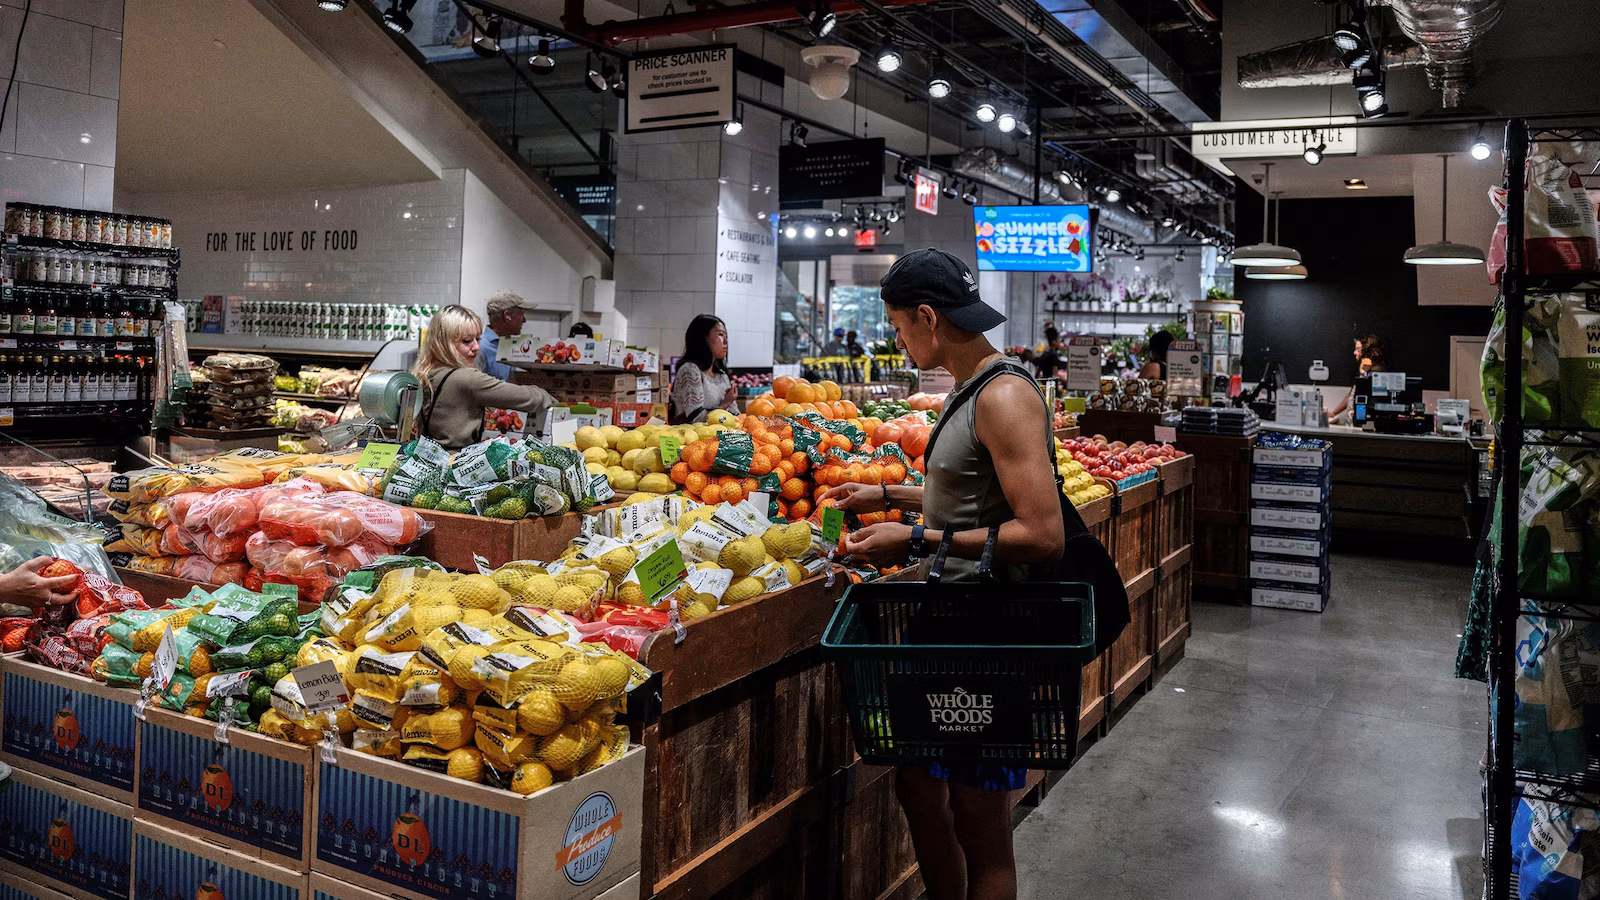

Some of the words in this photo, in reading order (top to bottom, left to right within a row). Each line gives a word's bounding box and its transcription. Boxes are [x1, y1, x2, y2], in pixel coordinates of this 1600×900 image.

[635, 56, 668, 71] PRICE
[671, 50, 726, 66] SCANNER
[665, 80, 682, 88] prices
[684, 77, 704, 85] located
[994, 221, 1068, 237] SUMMER
[207, 232, 228, 252] FOR
[236, 232, 256, 251] THE
[264, 232, 294, 250] LOVE
[302, 231, 316, 250] OF
[324, 230, 358, 250] FOOD
[995, 236, 1071, 256] SIZZLE
[458, 460, 485, 478] limes
[692, 526, 724, 544] lemons
[298, 678, 322, 690] Lemon
[322, 674, 340, 684] Bag
[926, 691, 994, 708] WHOLE
[930, 709, 993, 724] FOODS
[404, 728, 432, 738] lemons
[206, 783, 228, 800] DL
[184, 810, 219, 826] PRODUCE
[222, 821, 249, 836] CIRCUS
[574, 802, 609, 832] WHOLE
[398, 833, 425, 854] DL
[567, 822, 612, 863] Produce
[334, 834, 497, 899] MAGNIFICENT
[573, 846, 606, 877] FOODS
[373, 864, 413, 883] PRODUCE
[417, 877, 450, 895] CIRCUS
